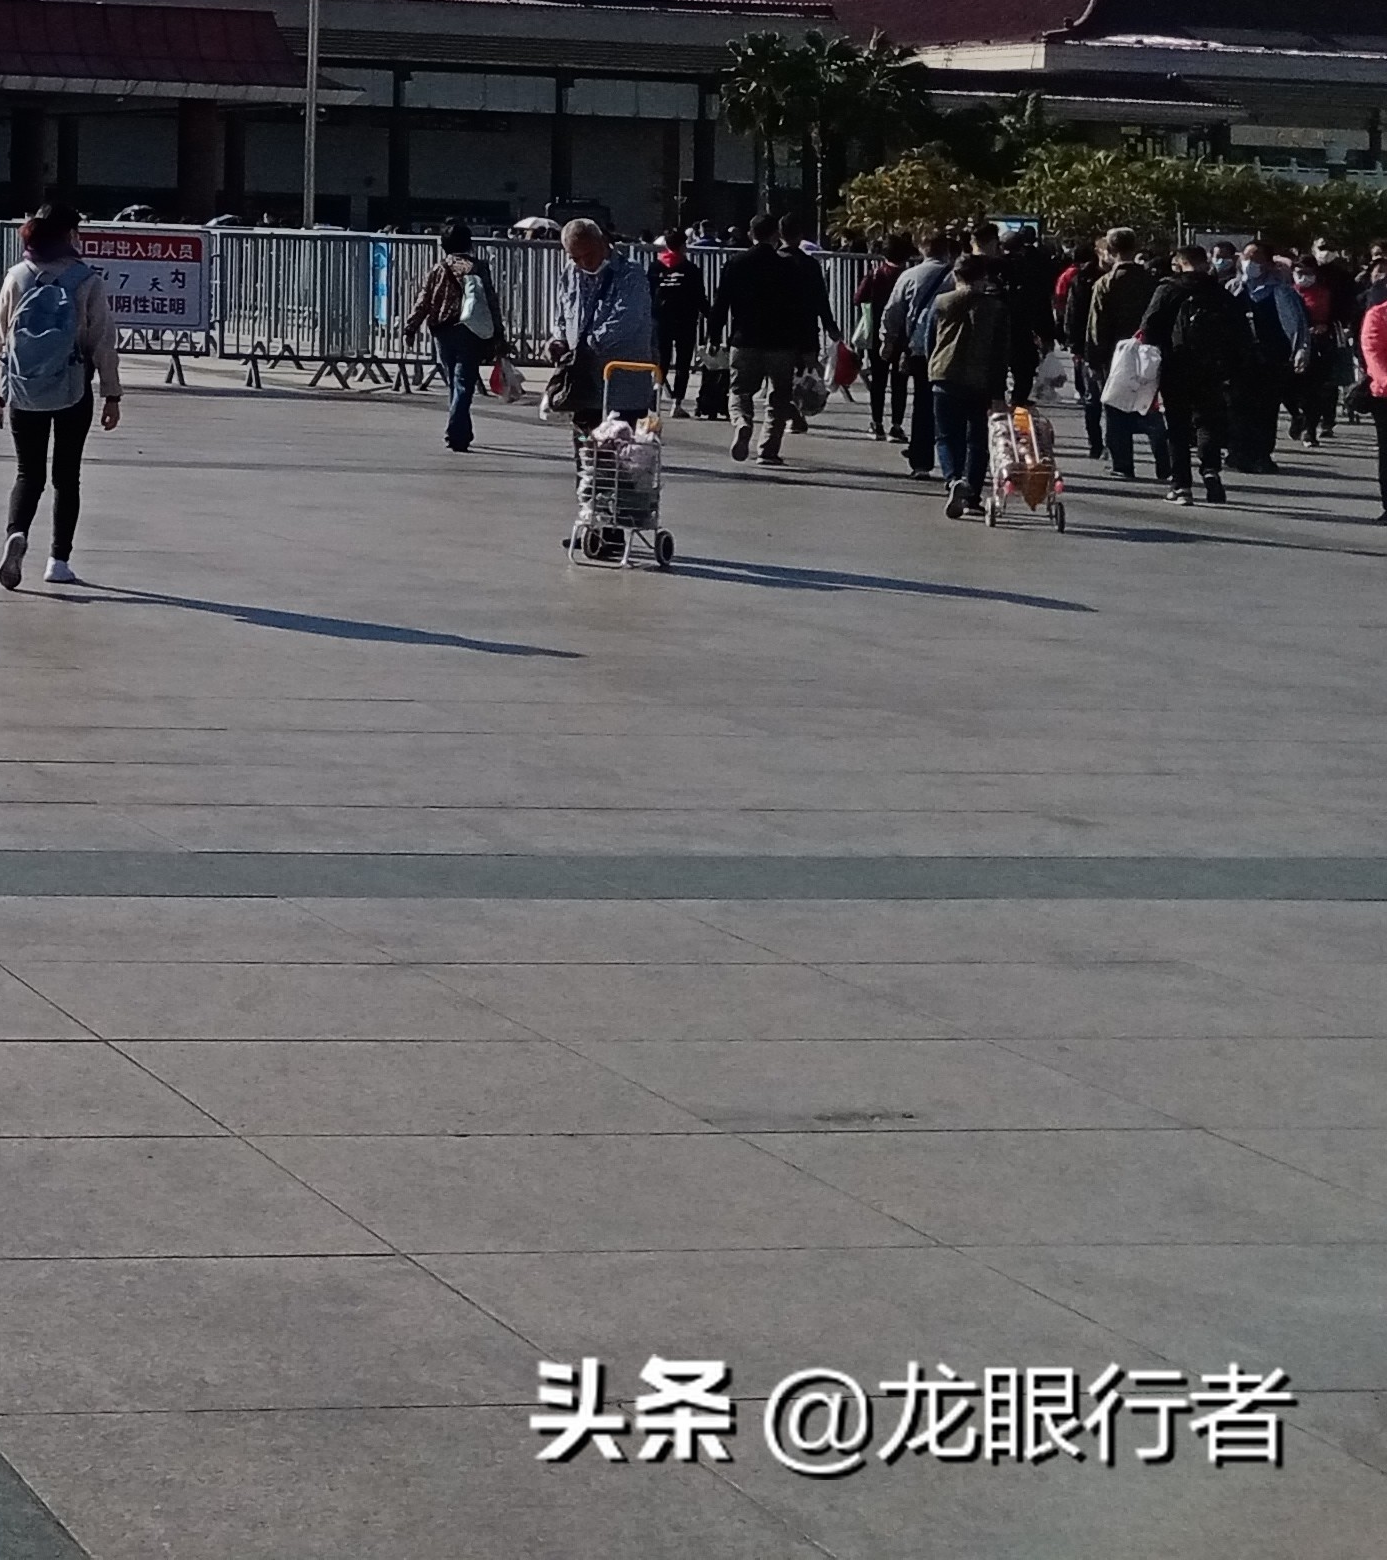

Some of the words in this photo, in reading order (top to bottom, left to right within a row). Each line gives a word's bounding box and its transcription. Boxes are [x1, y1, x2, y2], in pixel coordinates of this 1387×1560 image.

[79, 240, 193, 260] 口岸出入境人员
